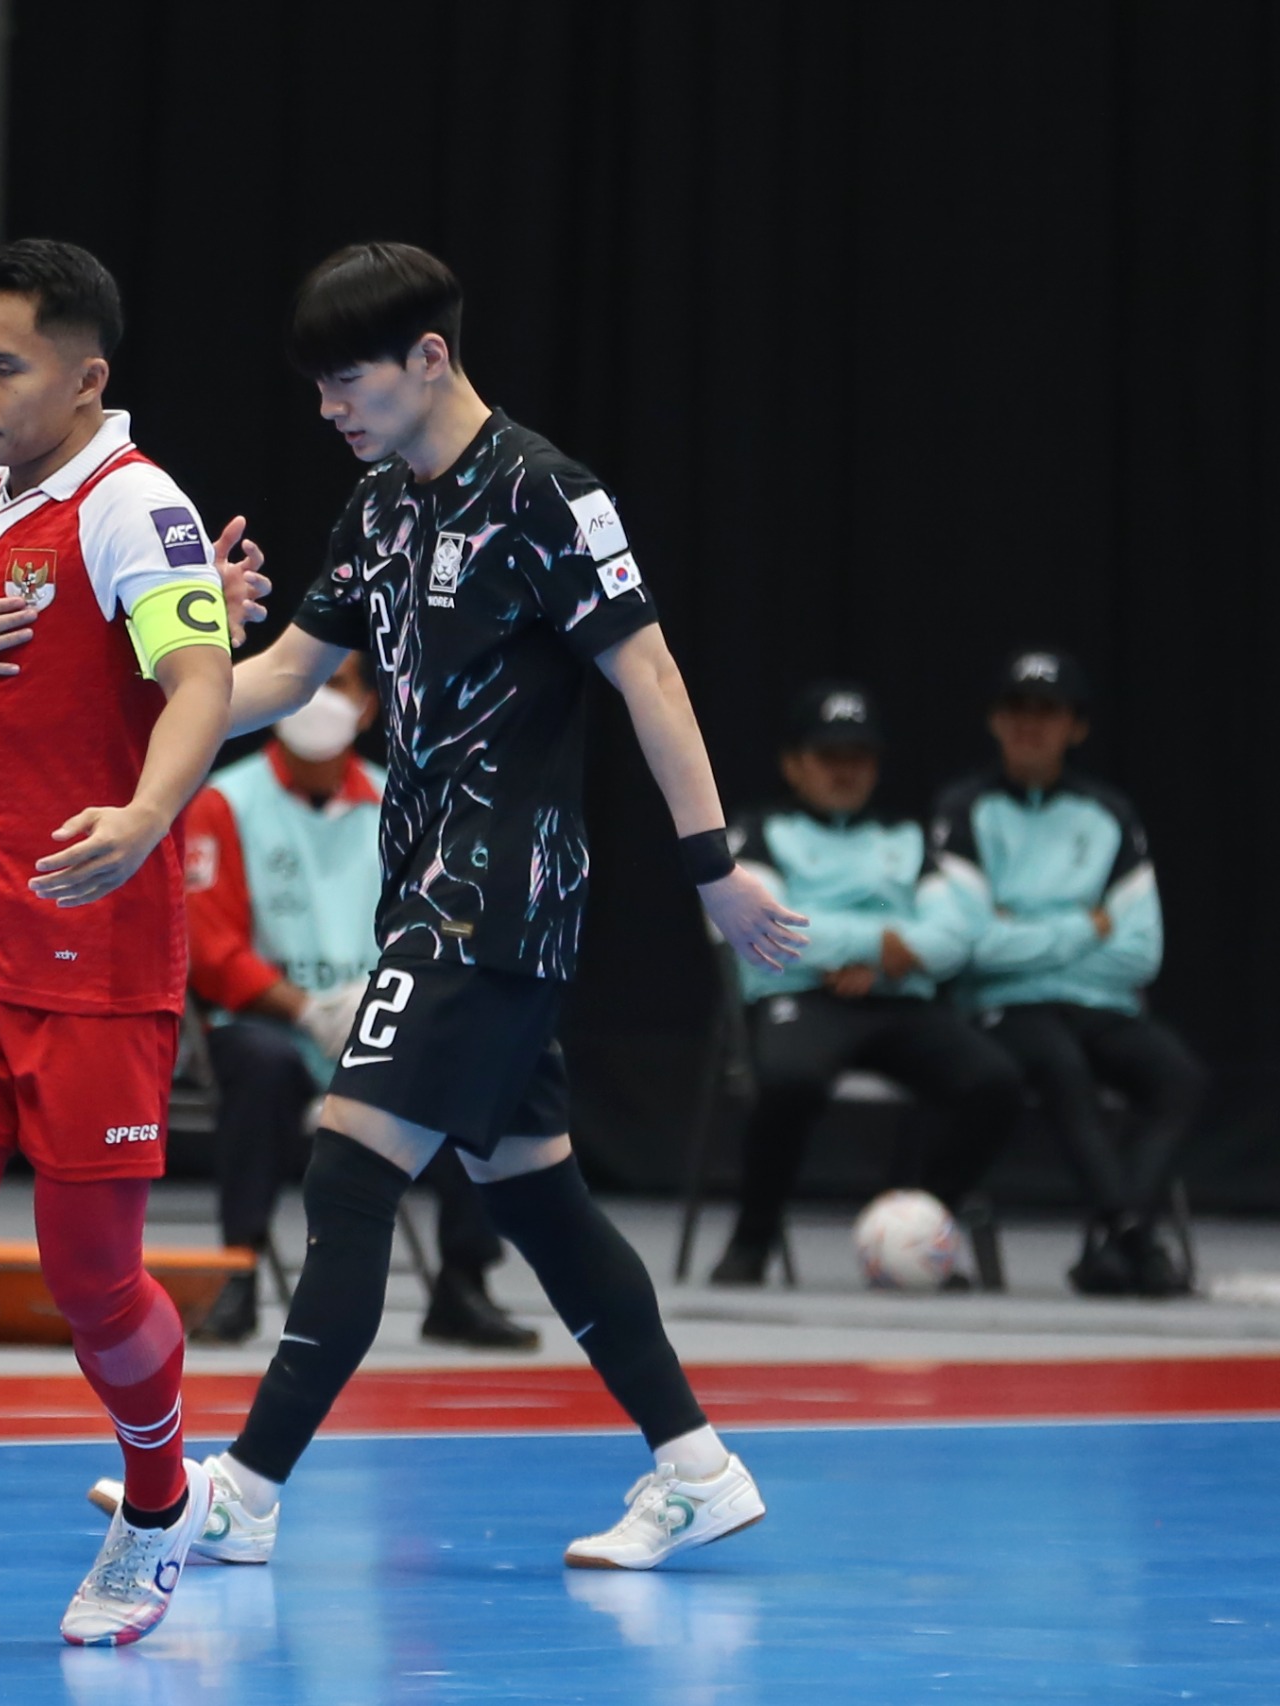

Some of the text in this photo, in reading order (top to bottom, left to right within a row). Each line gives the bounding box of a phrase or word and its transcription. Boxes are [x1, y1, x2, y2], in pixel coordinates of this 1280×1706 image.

[164, 523, 198, 543] AFC
[588, 511, 615, 535] AFC
[176, 590, 220, 632] C
[427, 595, 455, 608] KOREA
[370, 592, 399, 672] 2
[358, 967, 414, 1048] 2
[105, 1124, 159, 1144] SPECS
